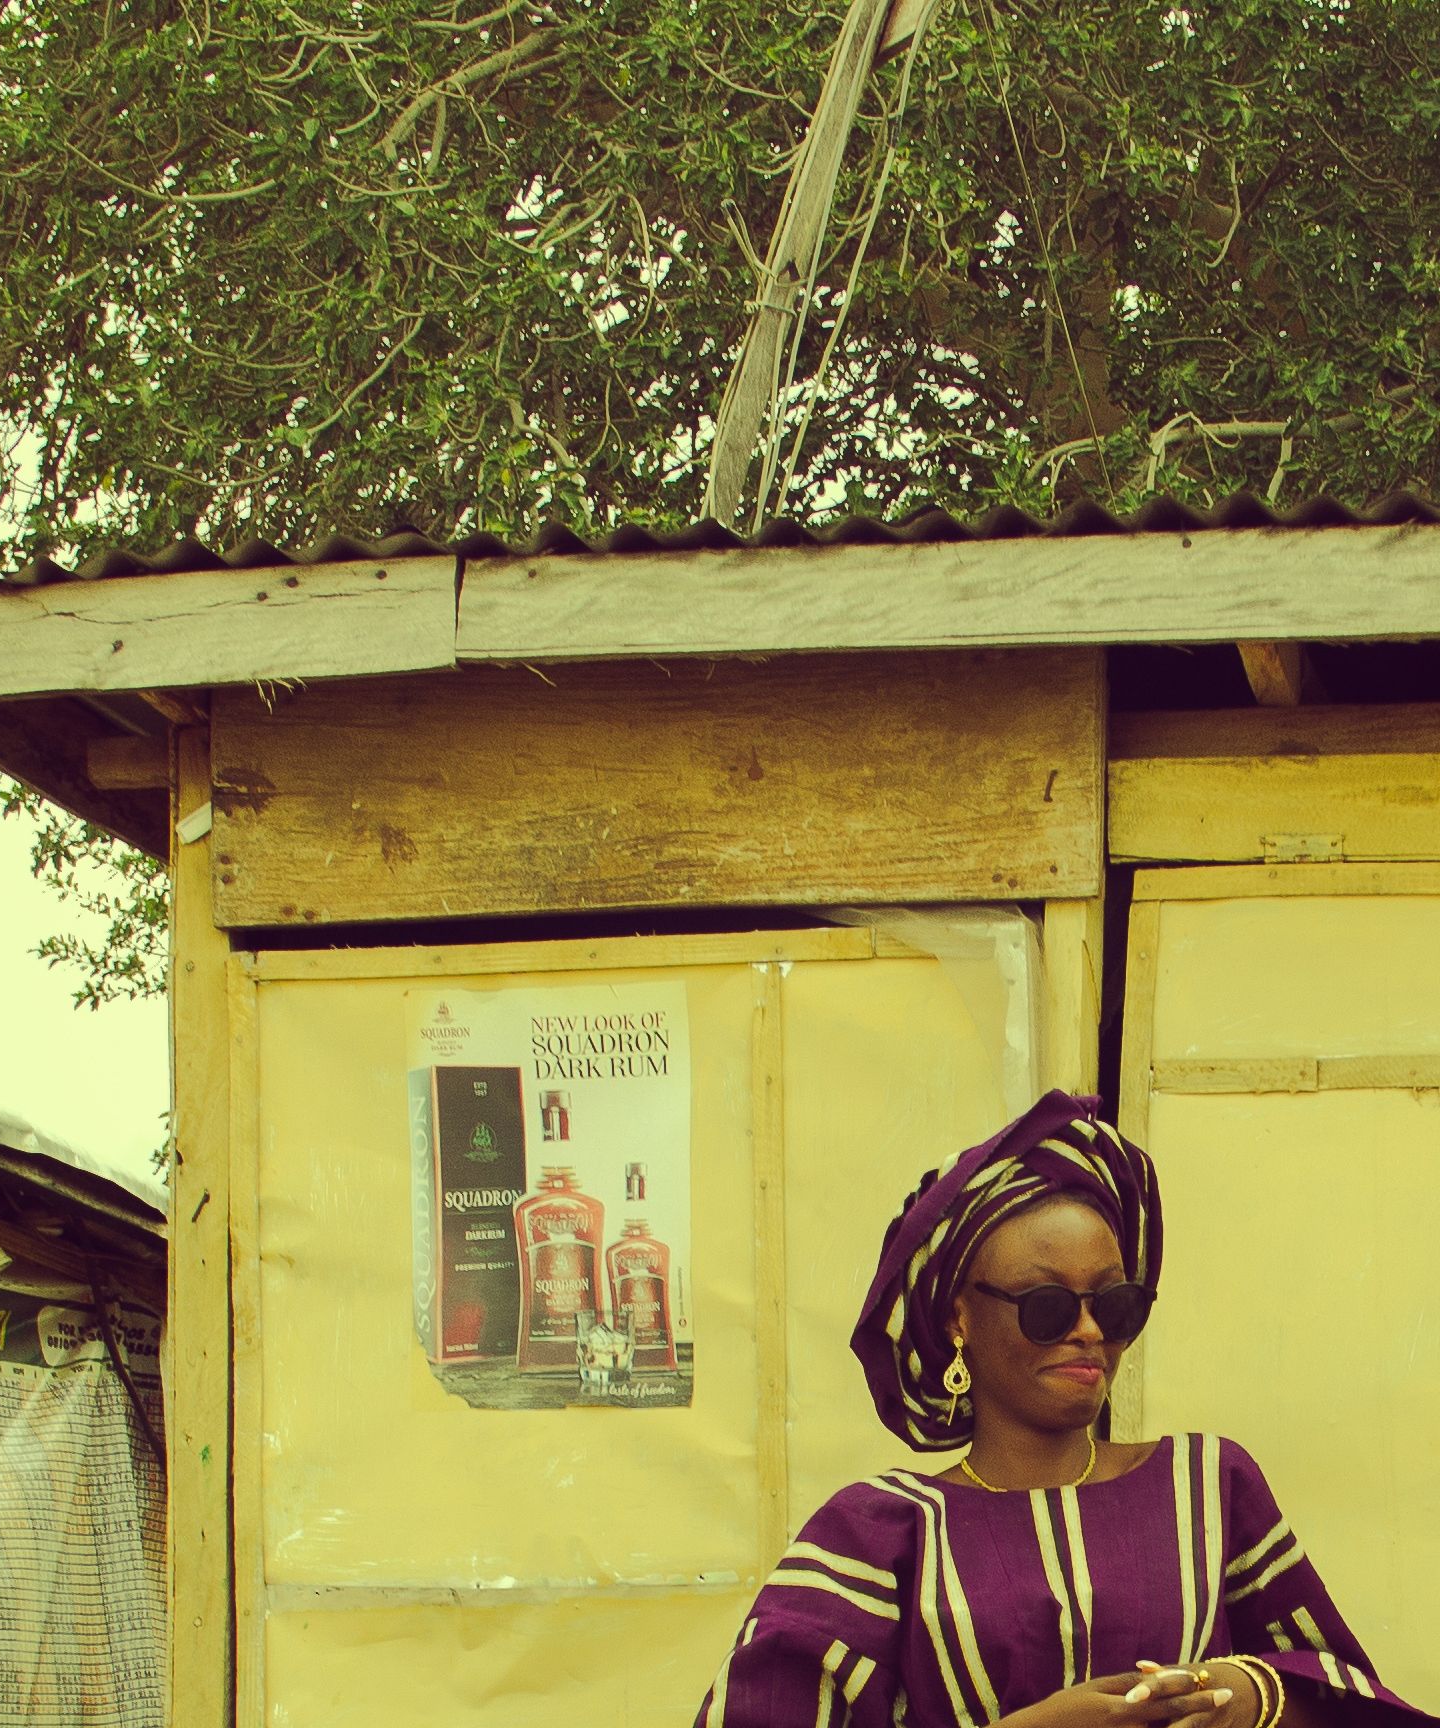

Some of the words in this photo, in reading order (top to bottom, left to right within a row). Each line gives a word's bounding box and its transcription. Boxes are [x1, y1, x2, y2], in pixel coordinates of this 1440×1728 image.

[420, 1026, 471, 1041] SQUADRON
[531, 1016, 578, 1033] NEW
[583, 1014, 636, 1032] LOOK
[641, 1011, 667, 1029] OF
[531, 1030, 670, 1059] SQUADRON
[534, 1056, 604, 1080] DARK
[610, 1055, 670, 1078] RUM
[444, 1189, 522, 1212] SQUADRON
